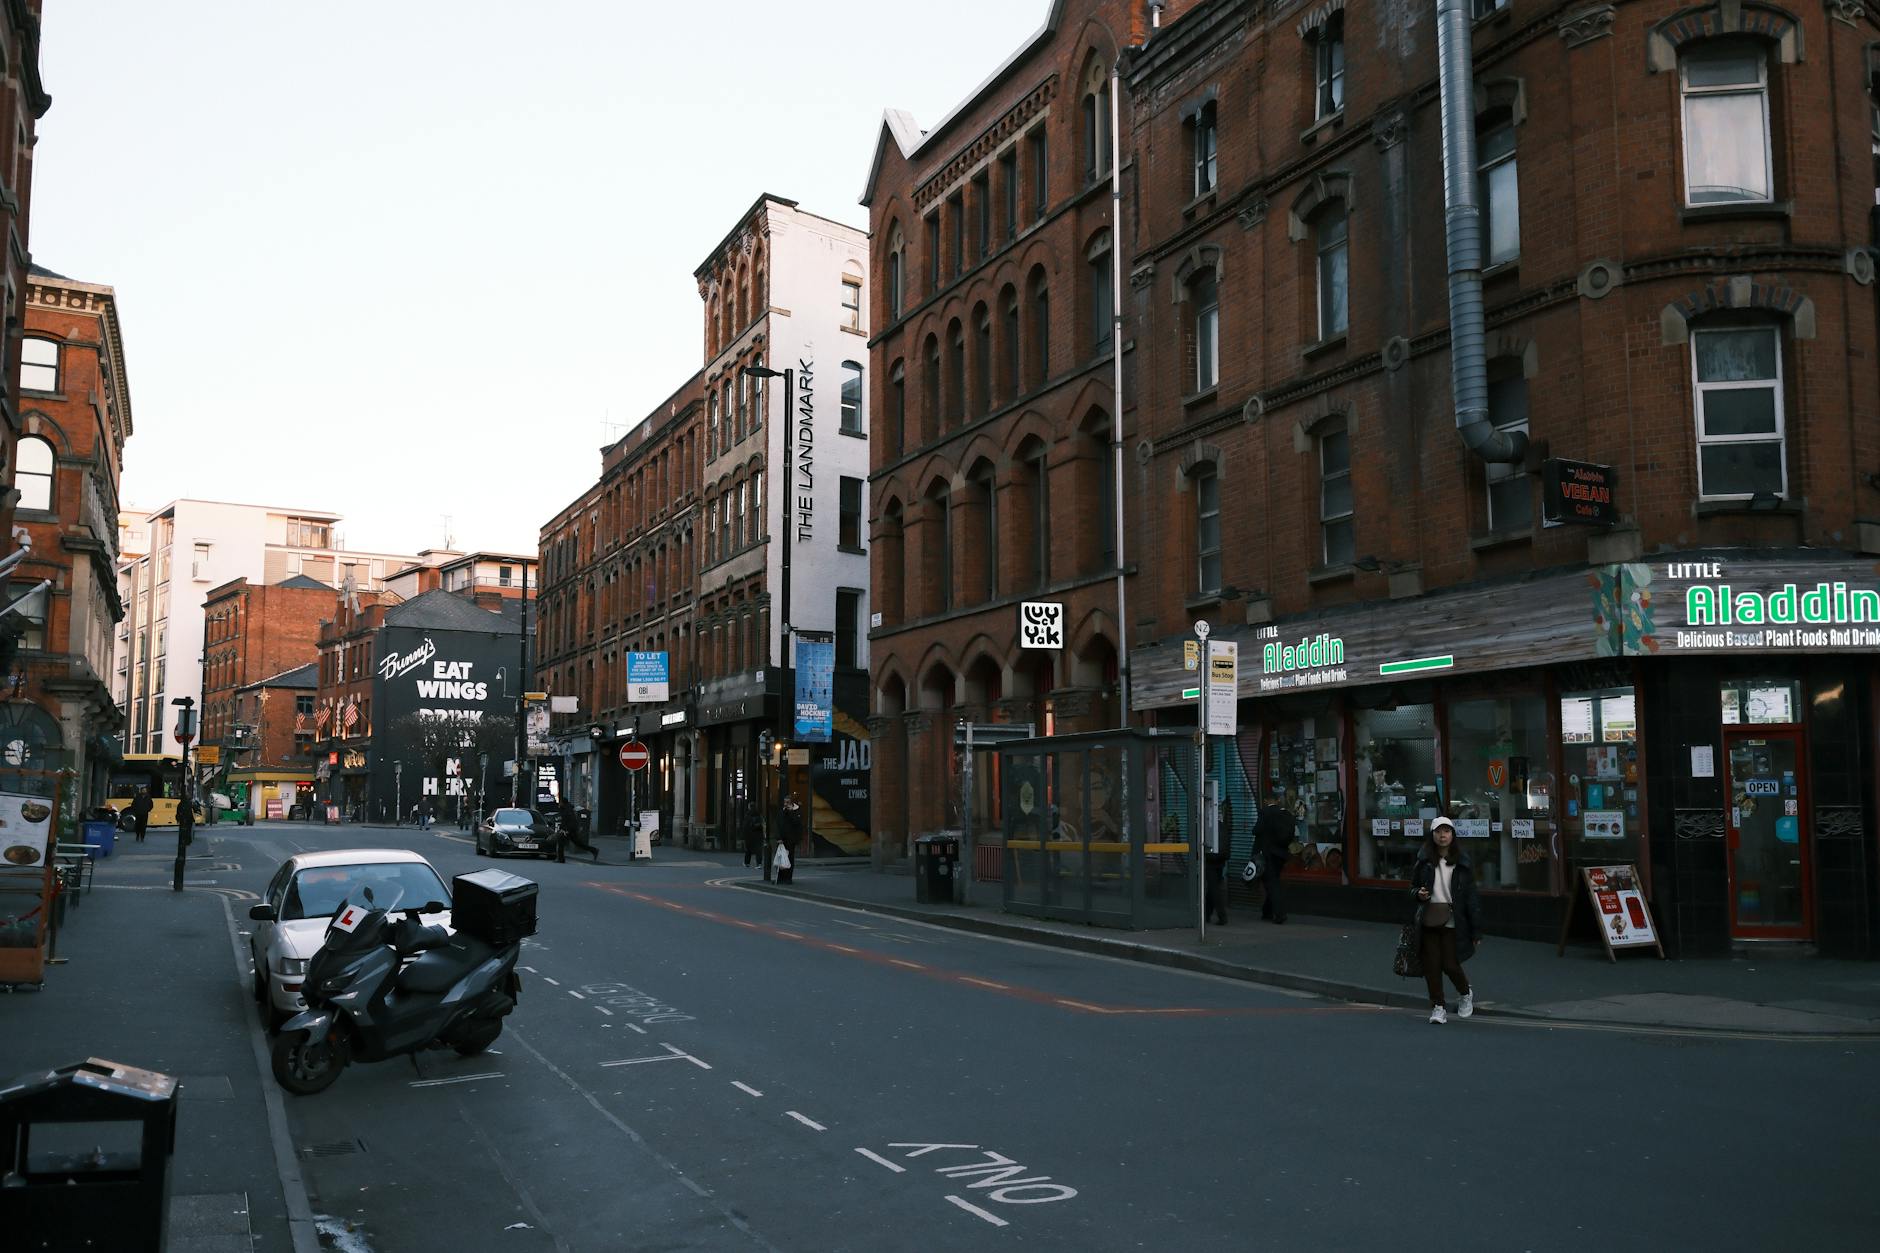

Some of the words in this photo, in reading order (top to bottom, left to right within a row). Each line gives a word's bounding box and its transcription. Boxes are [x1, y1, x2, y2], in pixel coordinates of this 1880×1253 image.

[799, 358, 814, 489] LANDMARK
[1561, 481, 1609, 503] VEGAN
[798, 496, 813, 543] THE
[1668, 563, 1721, 578] LITTLE
[1686, 582, 1880, 625] Aladdin
[1025, 626, 1059, 644] Yak
[1256, 626, 1278, 640] LITTLE
[1677, 631, 1724, 648] Delicious
[1726, 631, 1763, 647] Based
[1766, 630, 1794, 647] Plant
[1796, 629, 1827, 646] Foods
[1830, 629, 1850, 646] And
[378, 637, 436, 682] Bunny's
[1263, 633, 1344, 674] Aladdin
[433, 661, 473, 680] EAT
[1221, 672, 1233, 680] Stop
[1260, 678, 1280, 691] Delicious
[1295, 673, 1308, 687] Plant
[1308, 671, 1321, 685] Foods
[1321, 670, 1331, 683] And
[1331, 668, 1347, 682] Drinks
[416, 680, 488, 700] WINGS
[823, 758, 837, 770] THE
[1749, 782, 1776, 792] OPEN
[340, 909, 354, 926] L
[888, 1142, 1078, 1204] ONLY
